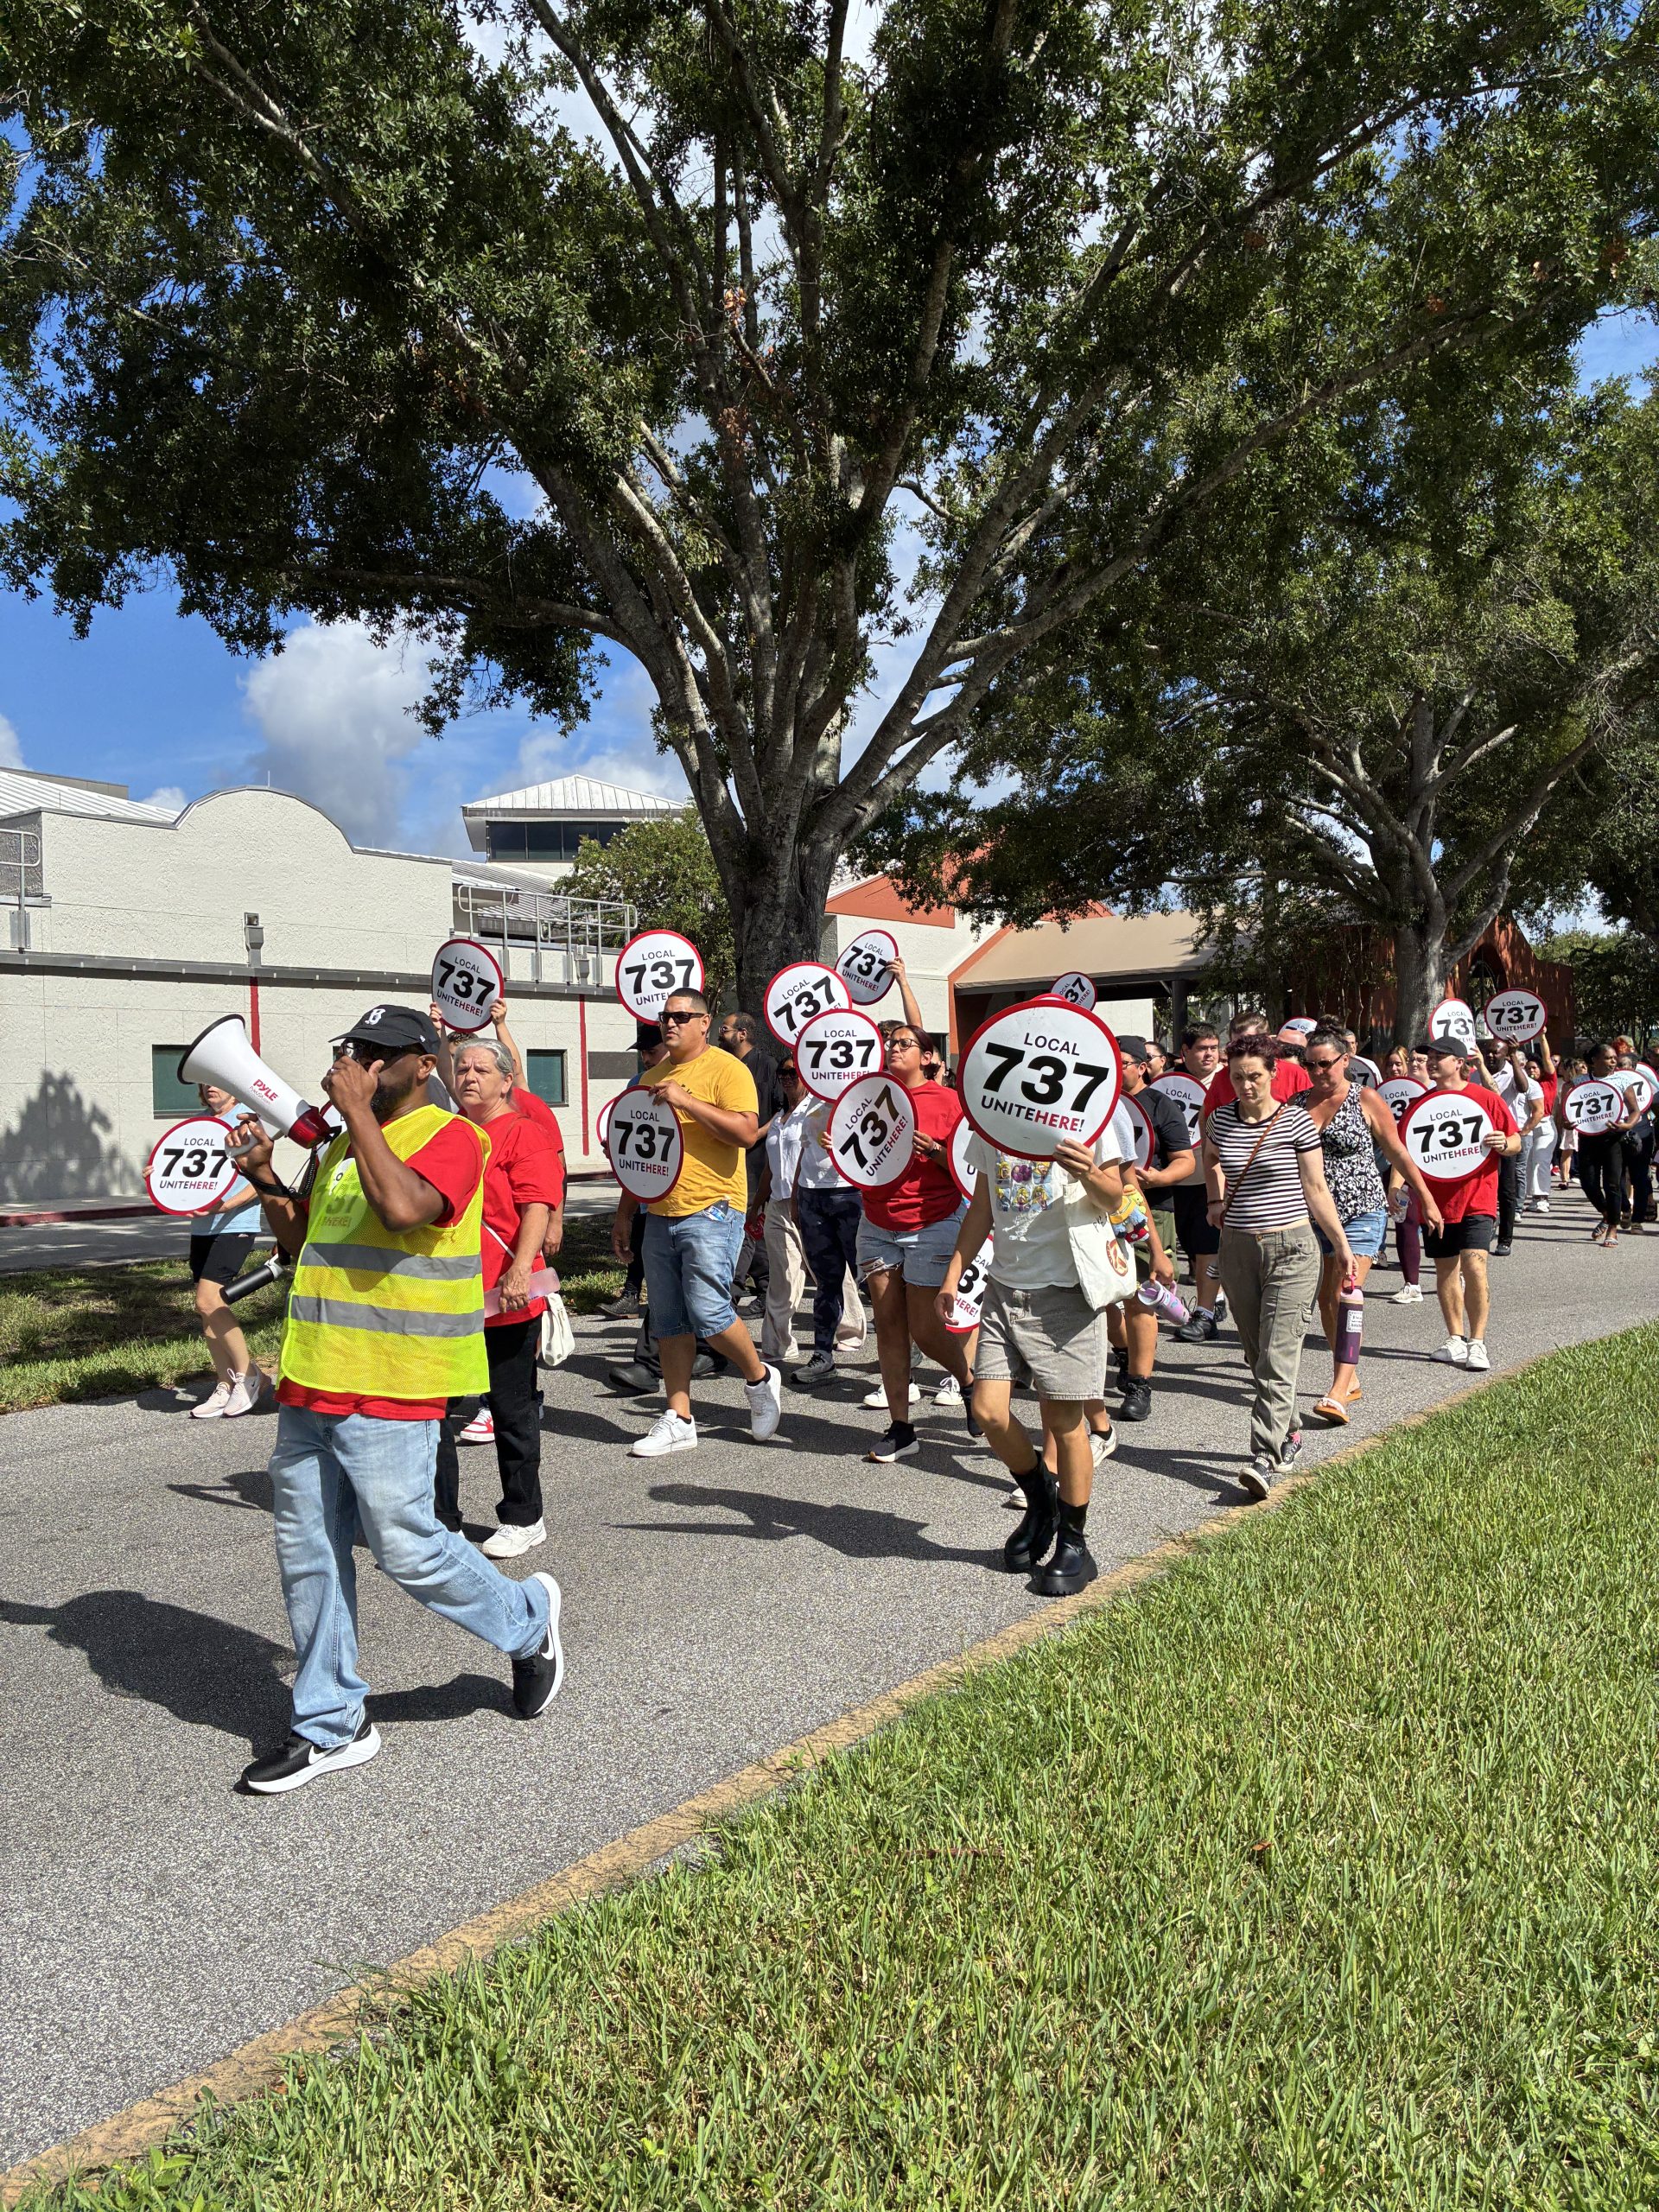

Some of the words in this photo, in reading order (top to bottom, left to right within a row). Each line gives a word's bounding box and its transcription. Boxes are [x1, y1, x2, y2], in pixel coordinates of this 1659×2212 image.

[642, 950, 675, 961] LOCAL
[865, 943, 884, 956] LOCAL
[454, 957, 480, 974] LOCAL
[844, 945, 888, 982] 737
[438, 959, 496, 1007] 737
[625, 959, 695, 995] 737
[842, 969, 879, 992] UNITEHERE!
[636, 992, 670, 1005] UNITE
[781, 979, 810, 1000] LOCAL
[1059, 983, 1071, 995] OCAL
[1065, 976, 1086, 1002] 37
[436, 989, 483, 1017] UNITEHERE!
[773, 976, 836, 1032] 737
[1491, 1004, 1540, 1026] 737
[1497, 1022, 1537, 1032] UNITEHERE!
[805, 1039, 875, 1069] 737
[1024, 1033, 1080, 1056] LOCAL
[811, 1071, 869, 1080] UNITEHER
[983, 1042, 1109, 1113] 737
[253, 1079, 278, 1102] PYLE
[1166, 1088, 1192, 1100] LOCAL
[1384, 1090, 1409, 1100] LOCAL
[1580, 1091, 1600, 1100] LOCAL
[631, 1109, 660, 1122] LOCAL
[846, 1097, 873, 1130] LOCAL
[981, 1096, 1085, 1132] UNITEHERE!
[1430, 1109, 1463, 1122] LOCAL
[1570, 1094, 1614, 1118] 737
[839, 1084, 899, 1170] 737
[1413, 1115, 1484, 1154] 737
[184, 1138, 215, 1147] LOCAL
[614, 1120, 675, 1162] 737
[866, 1116, 908, 1177] UNITEHERE!
[162, 1148, 227, 1178] 737
[1422, 1145, 1483, 1164] UNITEHERE!
[619, 1159, 669, 1177] UNITEHERE!
[159, 1180, 218, 1190] UNITEHERE!
[954, 1296, 978, 1318] HERE!
